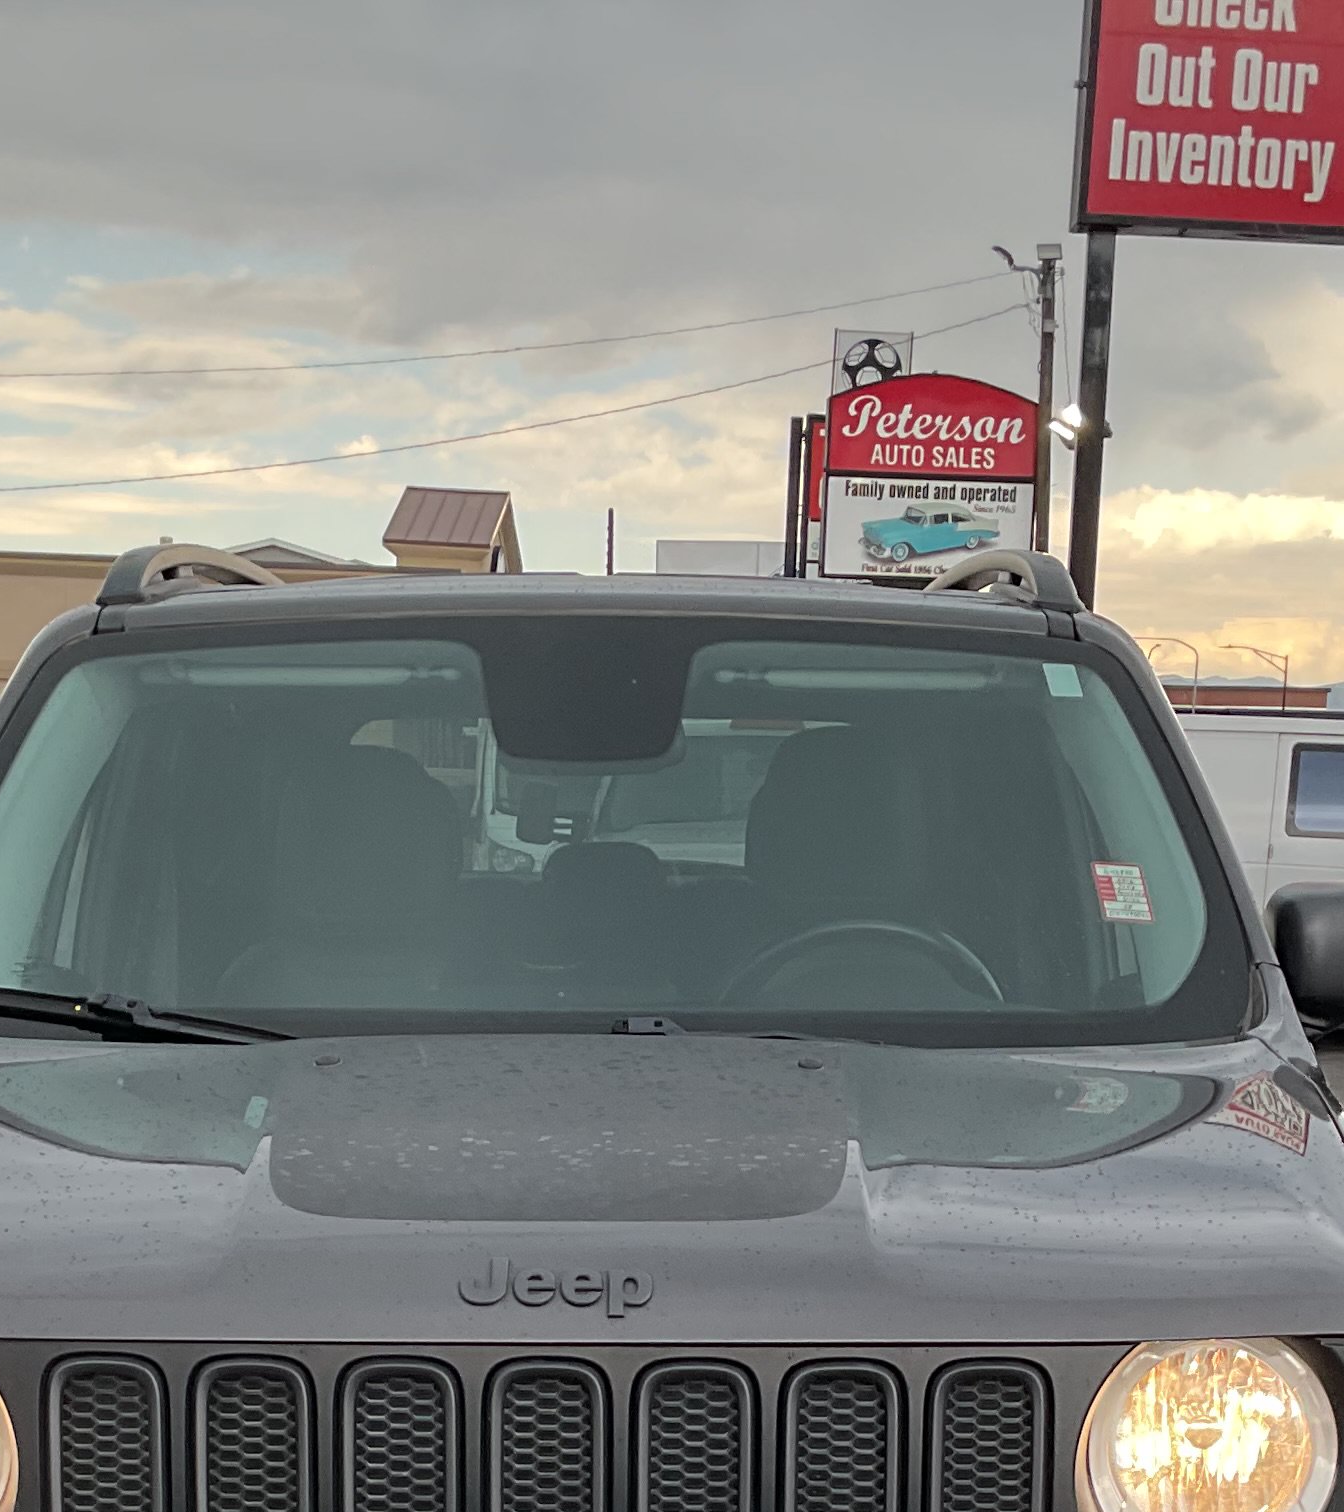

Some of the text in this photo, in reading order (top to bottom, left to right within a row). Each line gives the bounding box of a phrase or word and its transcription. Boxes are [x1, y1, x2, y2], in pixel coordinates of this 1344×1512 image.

[1136, 43, 1318, 114] Out Our
[1108, 118, 1335, 203] Inventory
[842, 395, 1026, 444] Peterson
[870, 444, 995, 470] AUTO SALES
[845, 479, 1017, 504] Family owned and operated
[458, 1256, 654, 1319] Jeep
